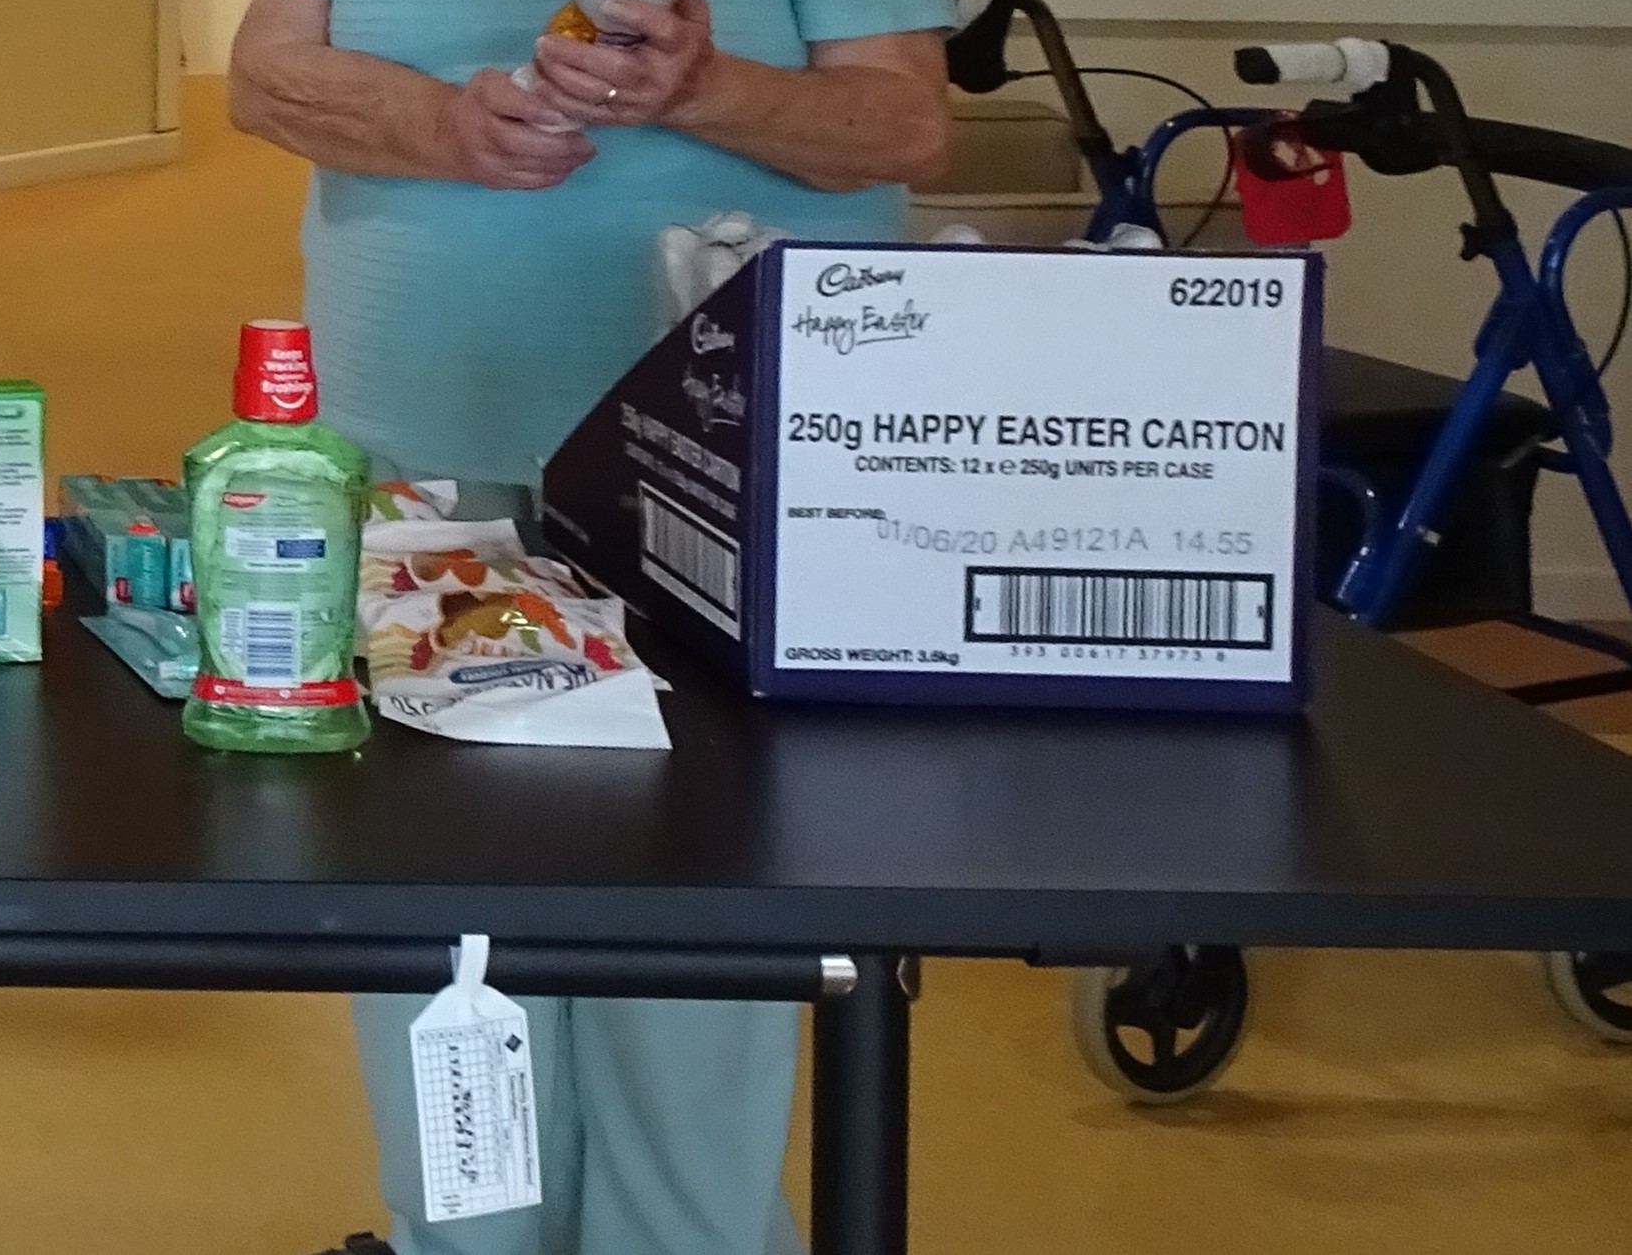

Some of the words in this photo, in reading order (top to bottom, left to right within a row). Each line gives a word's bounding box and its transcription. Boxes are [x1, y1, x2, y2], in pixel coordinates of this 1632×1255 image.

[1169, 278, 1284, 308] 622019
[791, 305, 858, 356] Happy
[860, 298, 932, 338] Easter
[788, 412, 863, 451] 250g
[873, 413, 986, 445] HAPPY
[997, 415, 1131, 448] EASTER
[1141, 418, 1286, 452] CARTON
[854, 455, 956, 474] CONTENTS:
[961, 458, 981, 474] 12
[984, 461, 995, 474] x
[1020, 458, 1062, 480] 250g
[1064, 459, 1118, 478] UNITS
[1123, 461, 1160, 479] PER
[1164, 462, 1215, 480] CASE
[1007, 525, 1150, 554] A49121A
[1172, 528, 1255, 556] 14.55
[786, 647, 843, 662] GROSS
[846, 648, 914, 663] WEIGHT:
